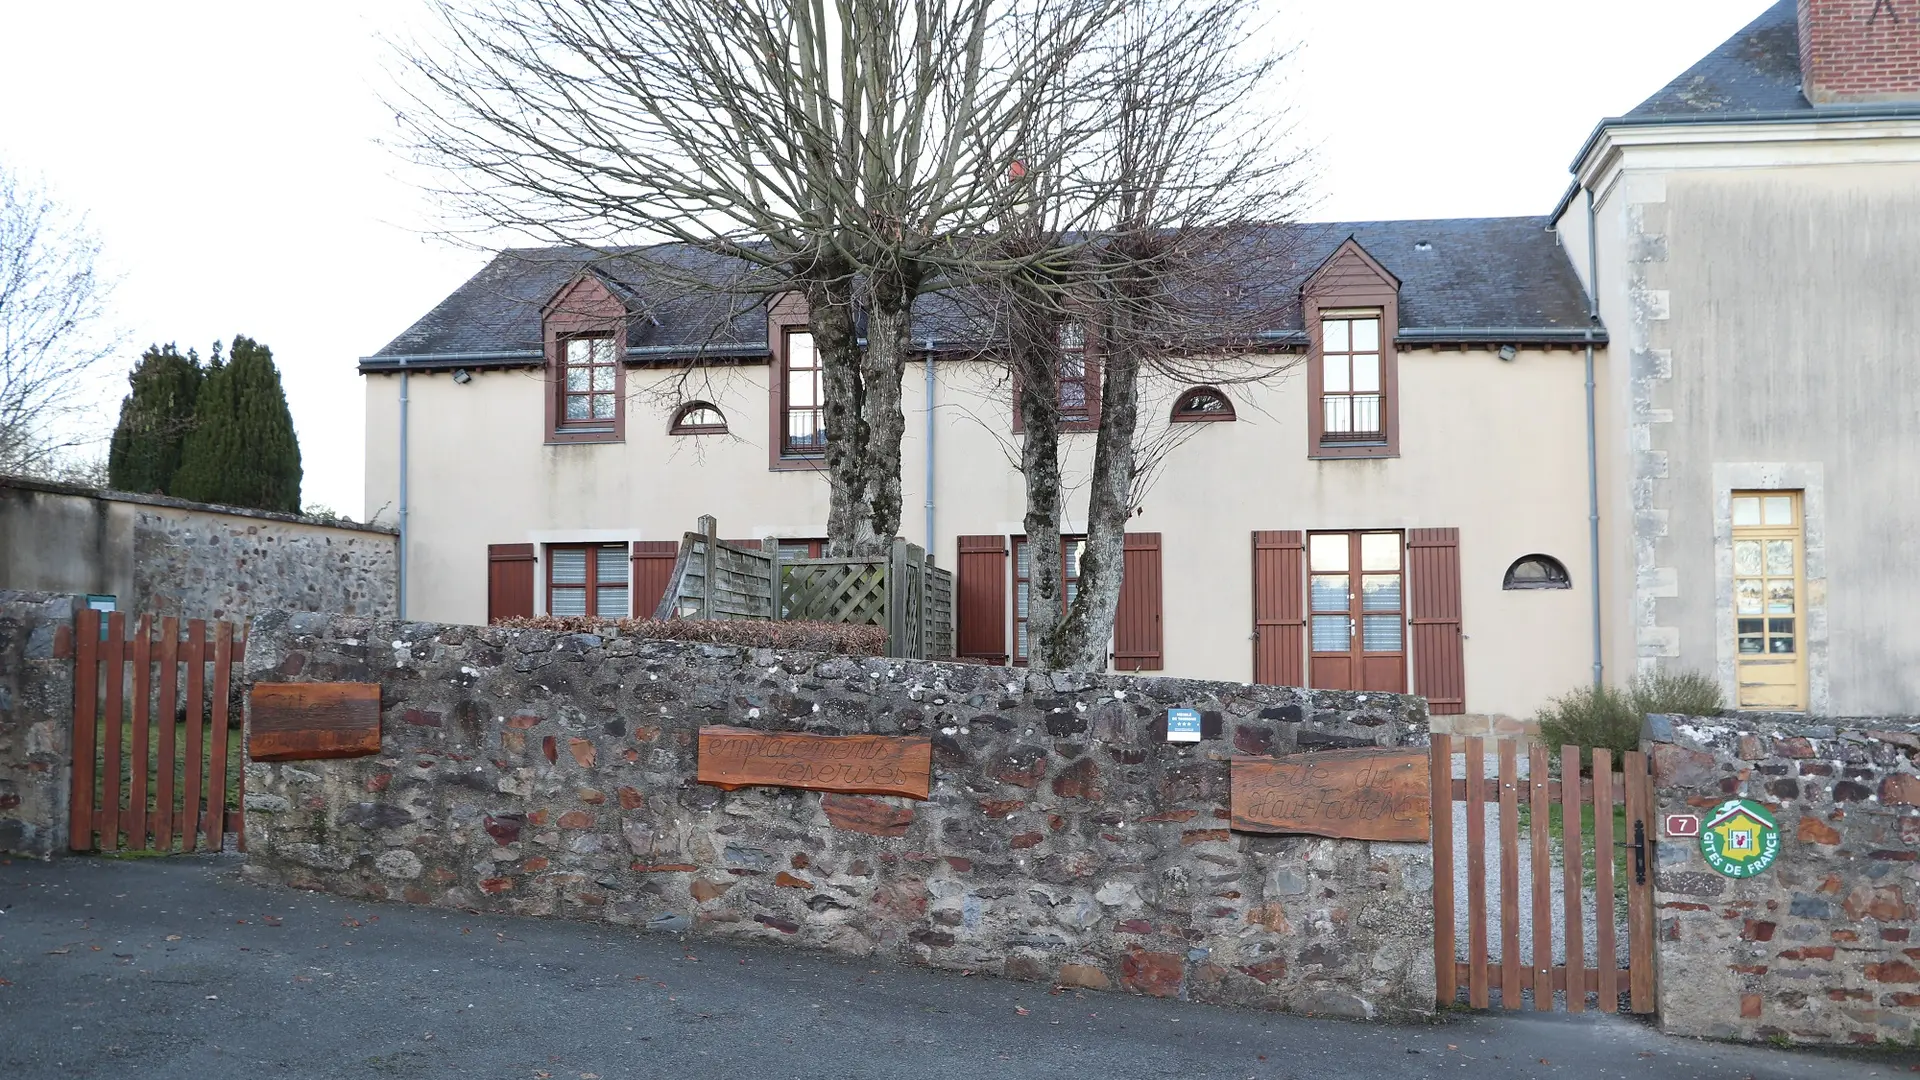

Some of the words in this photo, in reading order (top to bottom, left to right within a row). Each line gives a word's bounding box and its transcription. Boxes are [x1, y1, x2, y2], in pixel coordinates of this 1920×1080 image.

[708, 735, 890, 771] emplacements
[1354, 749, 1394, 789] du
[772, 761, 908, 786] réservés
[1678, 819, 1688, 832] 7
[1724, 863, 1742, 876] DE
[1747, 832, 1777, 874] FRANCE
